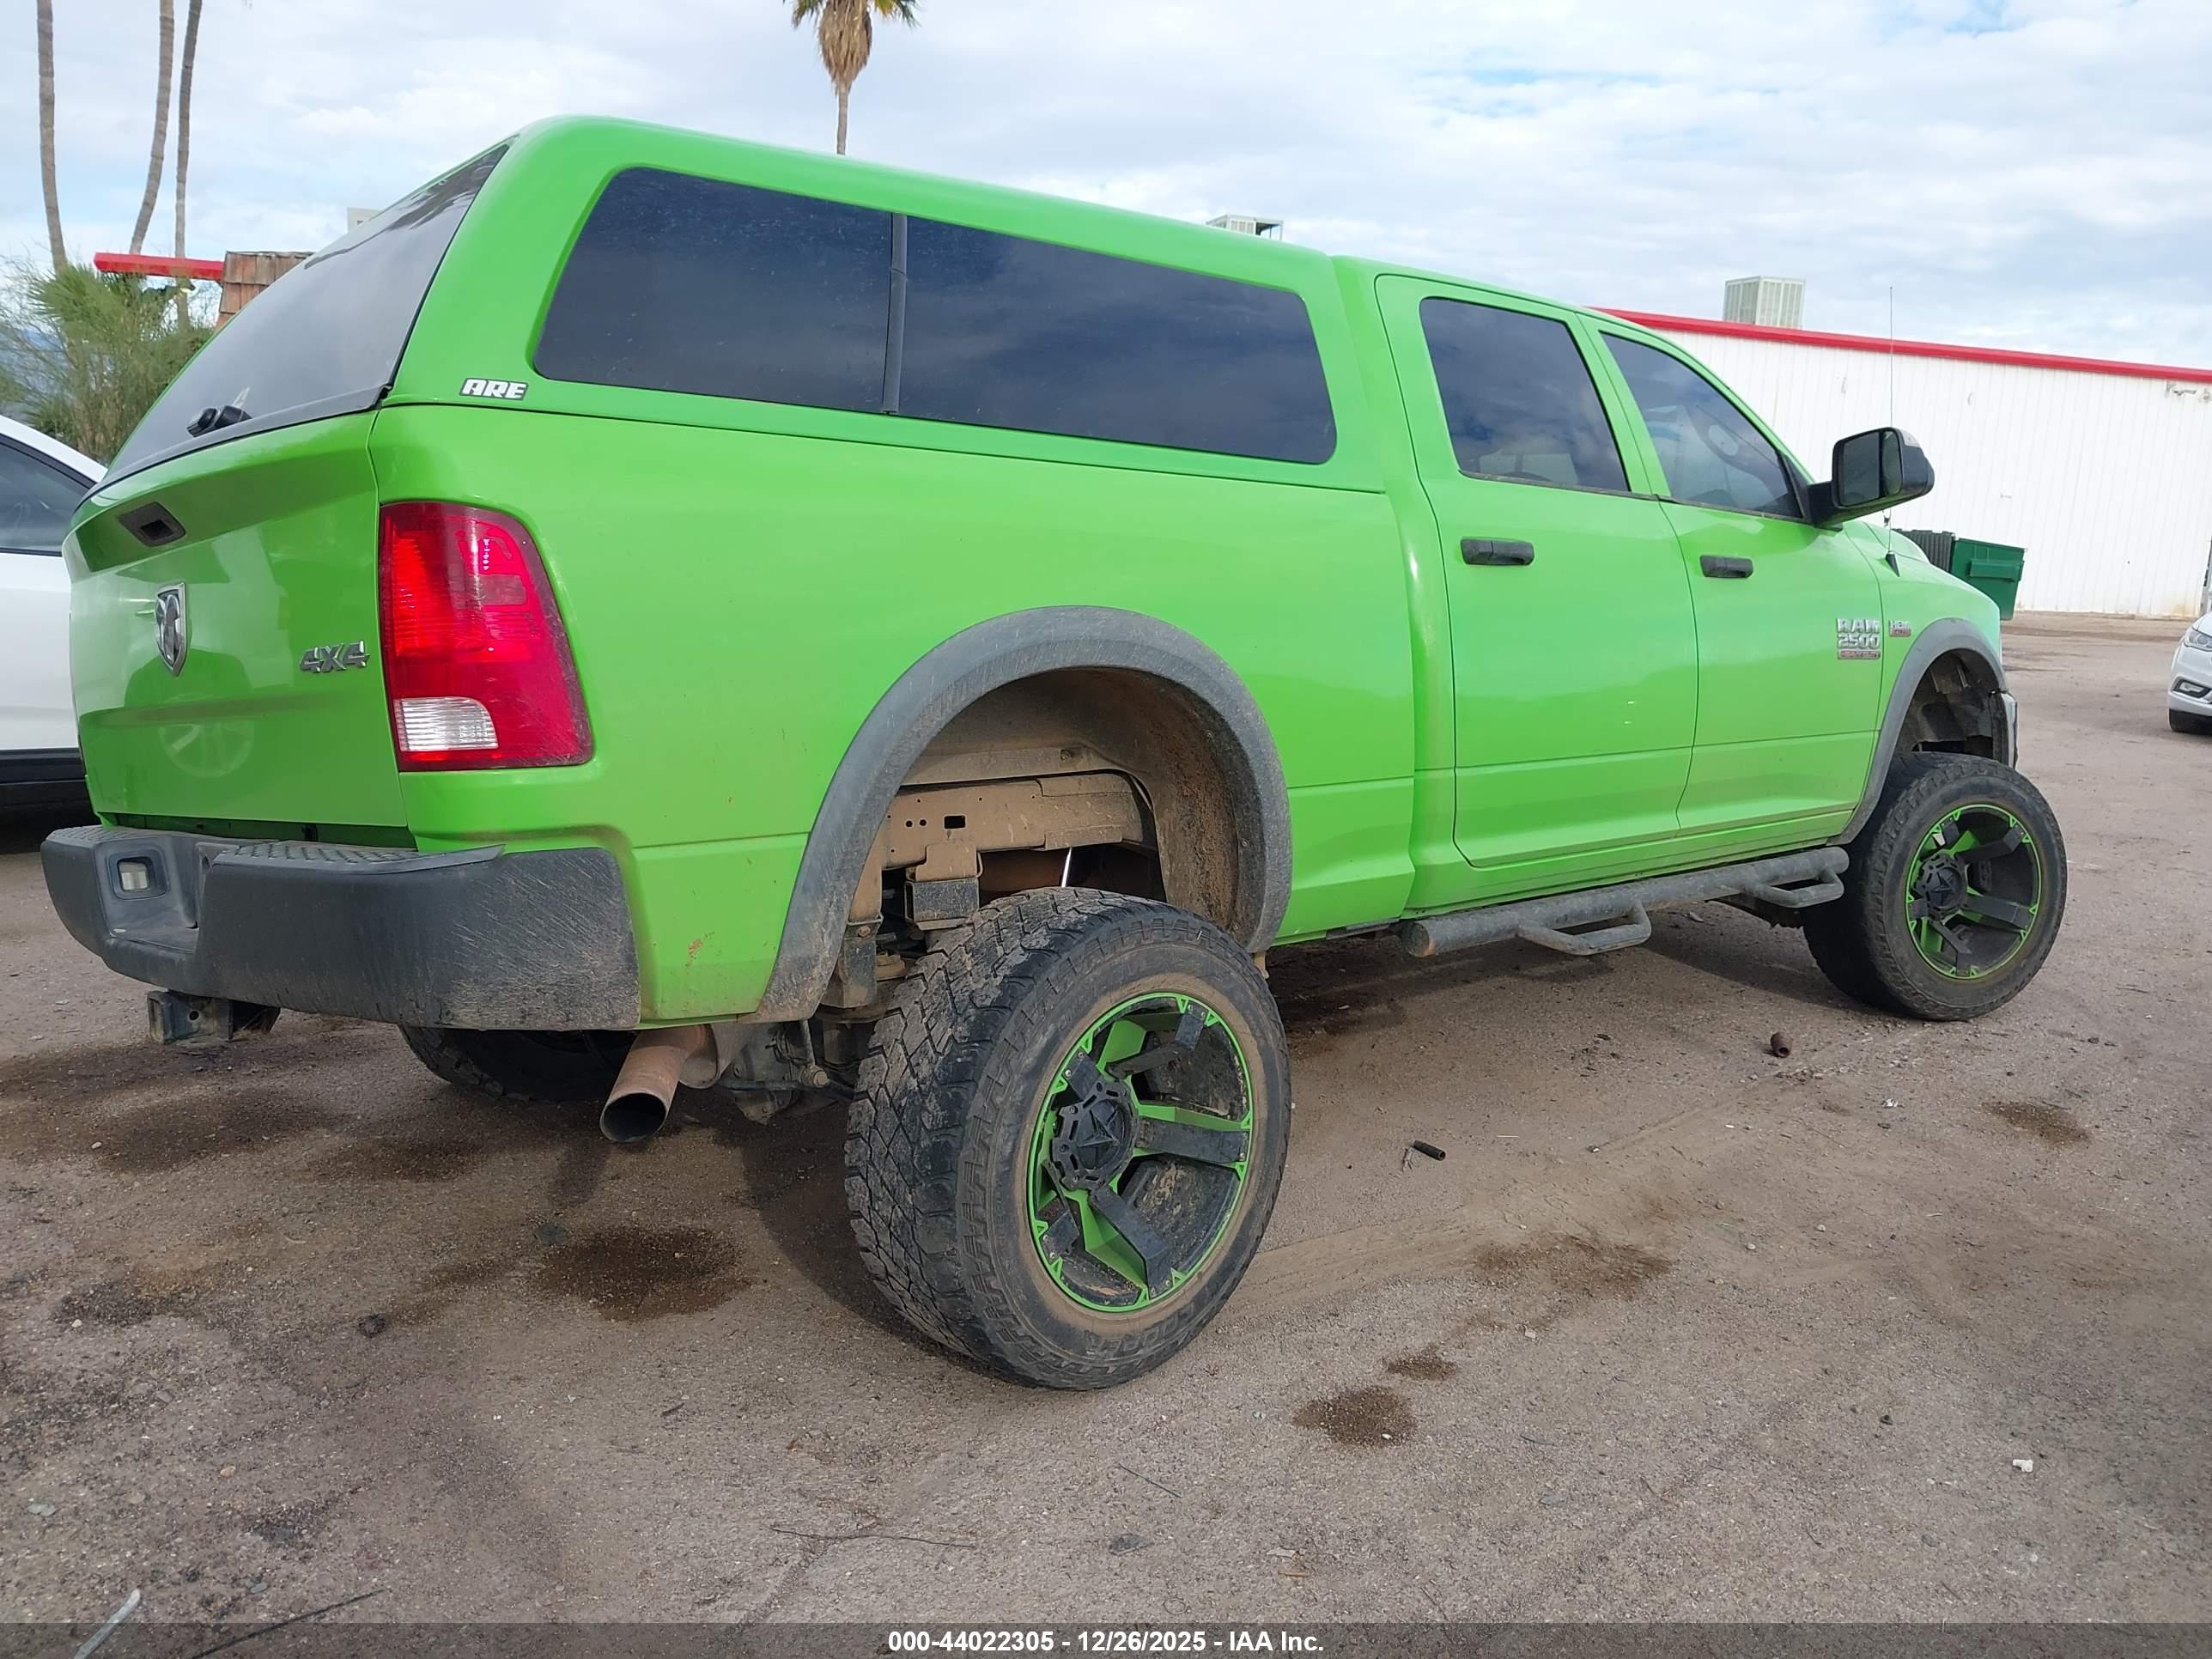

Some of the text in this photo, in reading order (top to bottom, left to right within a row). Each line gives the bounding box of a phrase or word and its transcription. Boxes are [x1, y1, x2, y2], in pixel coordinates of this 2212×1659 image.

[460, 379, 527, 399] ARE
[1836, 618, 1881, 634] RAM
[1837, 633, 1881, 649] 2500
